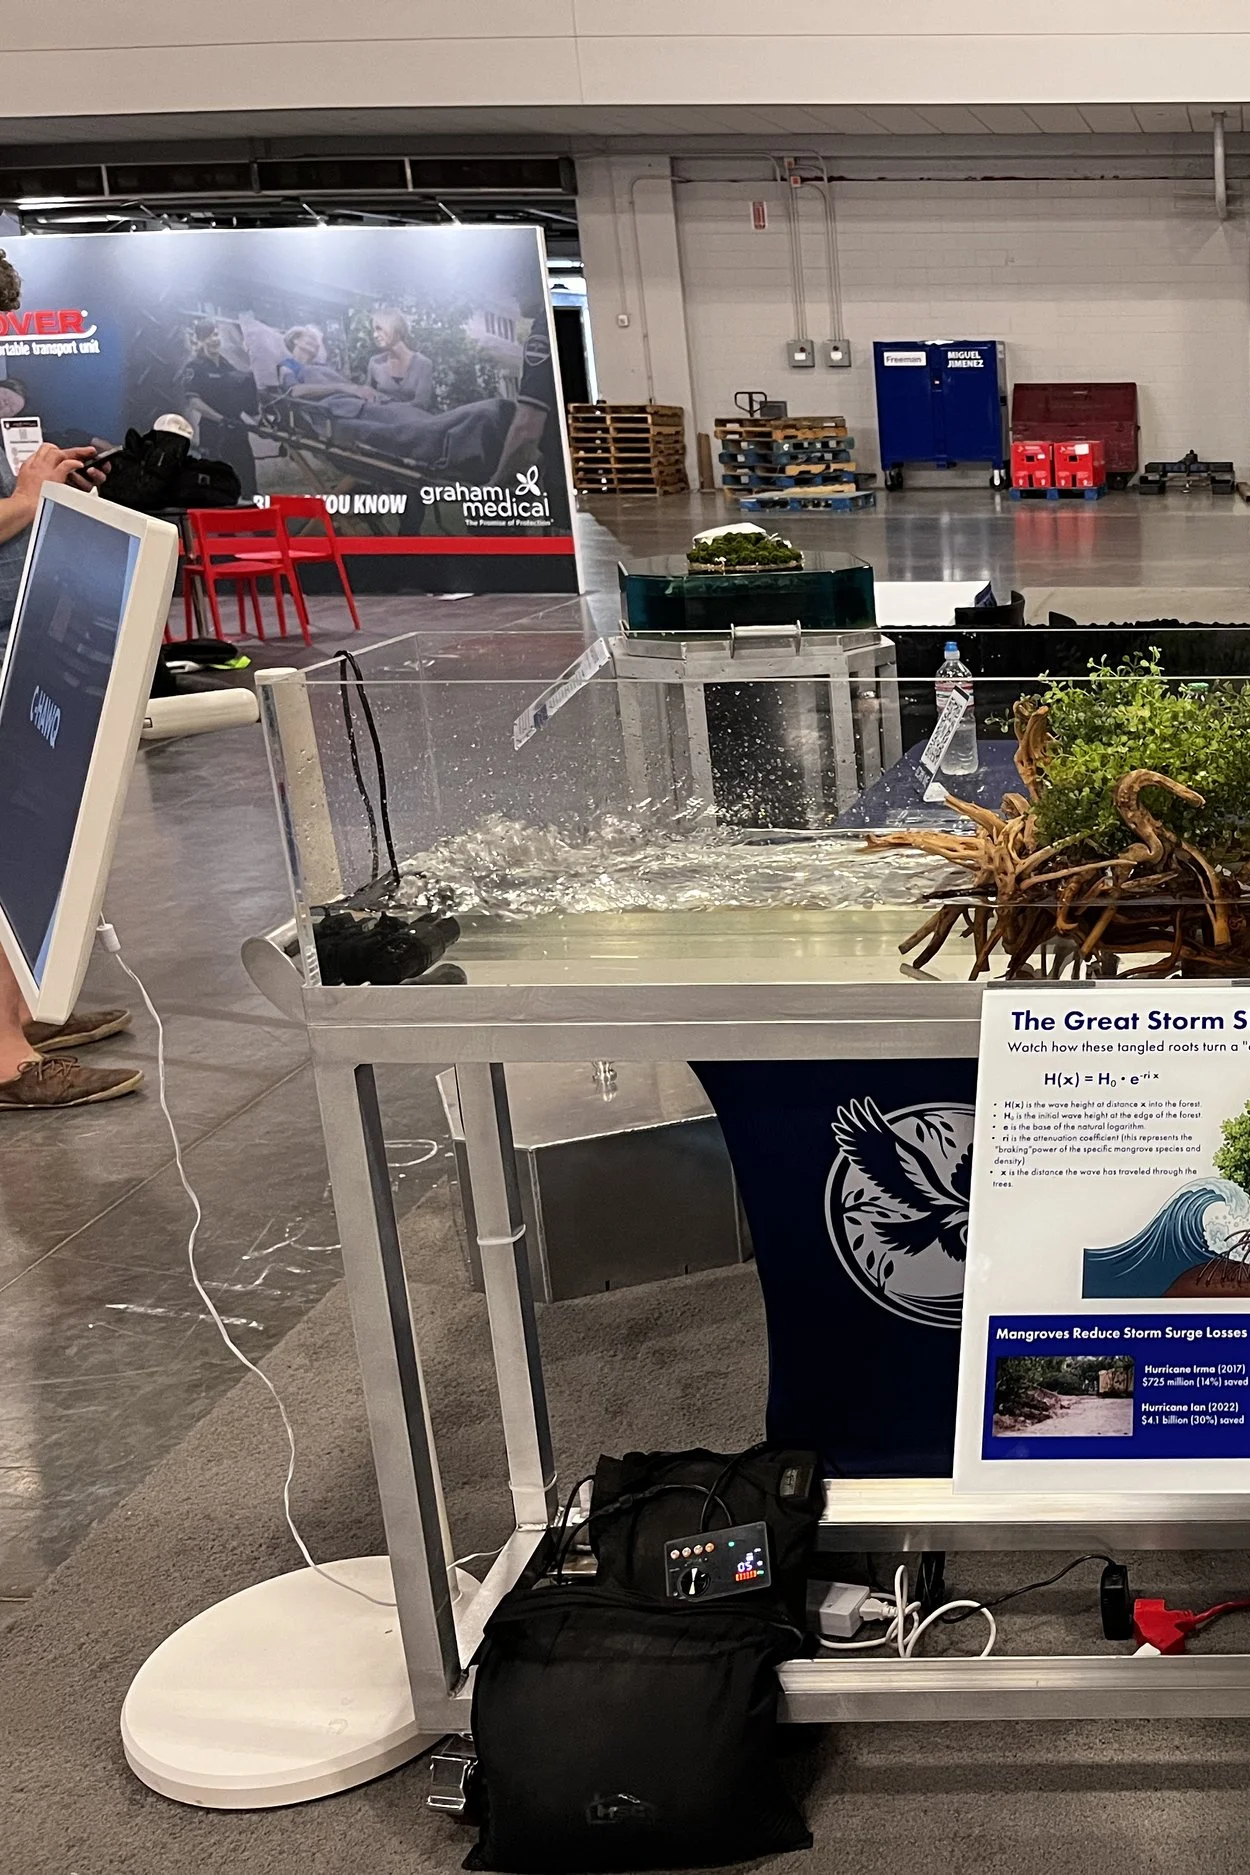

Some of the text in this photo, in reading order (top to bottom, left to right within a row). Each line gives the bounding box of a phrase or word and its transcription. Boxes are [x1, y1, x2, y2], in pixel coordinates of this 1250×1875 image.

[0, 339, 100, 357] rtable transport unit
[948, 351, 981, 359] MIGUEL
[420, 482, 502, 504] graham
[324, 495, 407, 514] OU KNOW
[463, 489, 550, 518] medical
[1012, 1011, 1055, 1031] The
[1064, 1011, 1139, 1031] Great
[1148, 1011, 1224, 1030] Storm
[1008, 1042, 1048, 1052] Watch
[1051, 1042, 1079, 1052] how
[1082, 1042, 1113, 1052] these
[1117, 1041, 1164, 1055] tangled
[1168, 1042, 1199, 1052] roots
[1203, 1042, 1226, 1051] turn
[1231, 1043, 1238, 1052] a
[1045, 1072, 1079, 1088] H(x)
[996, 1327, 1247, 1342] Mangroves Reduce Storm Surge Losses
[1145, 1364, 1245, 1375] Hurricane Irma (2017)
[1143, 1377, 1248, 1387] $725 million (14%) saved
[1142, 1402, 1238, 1413] Hurricane Ian (2022)
[1142, 1415, 1244, 1426] $4.1 billion (30%) saved
